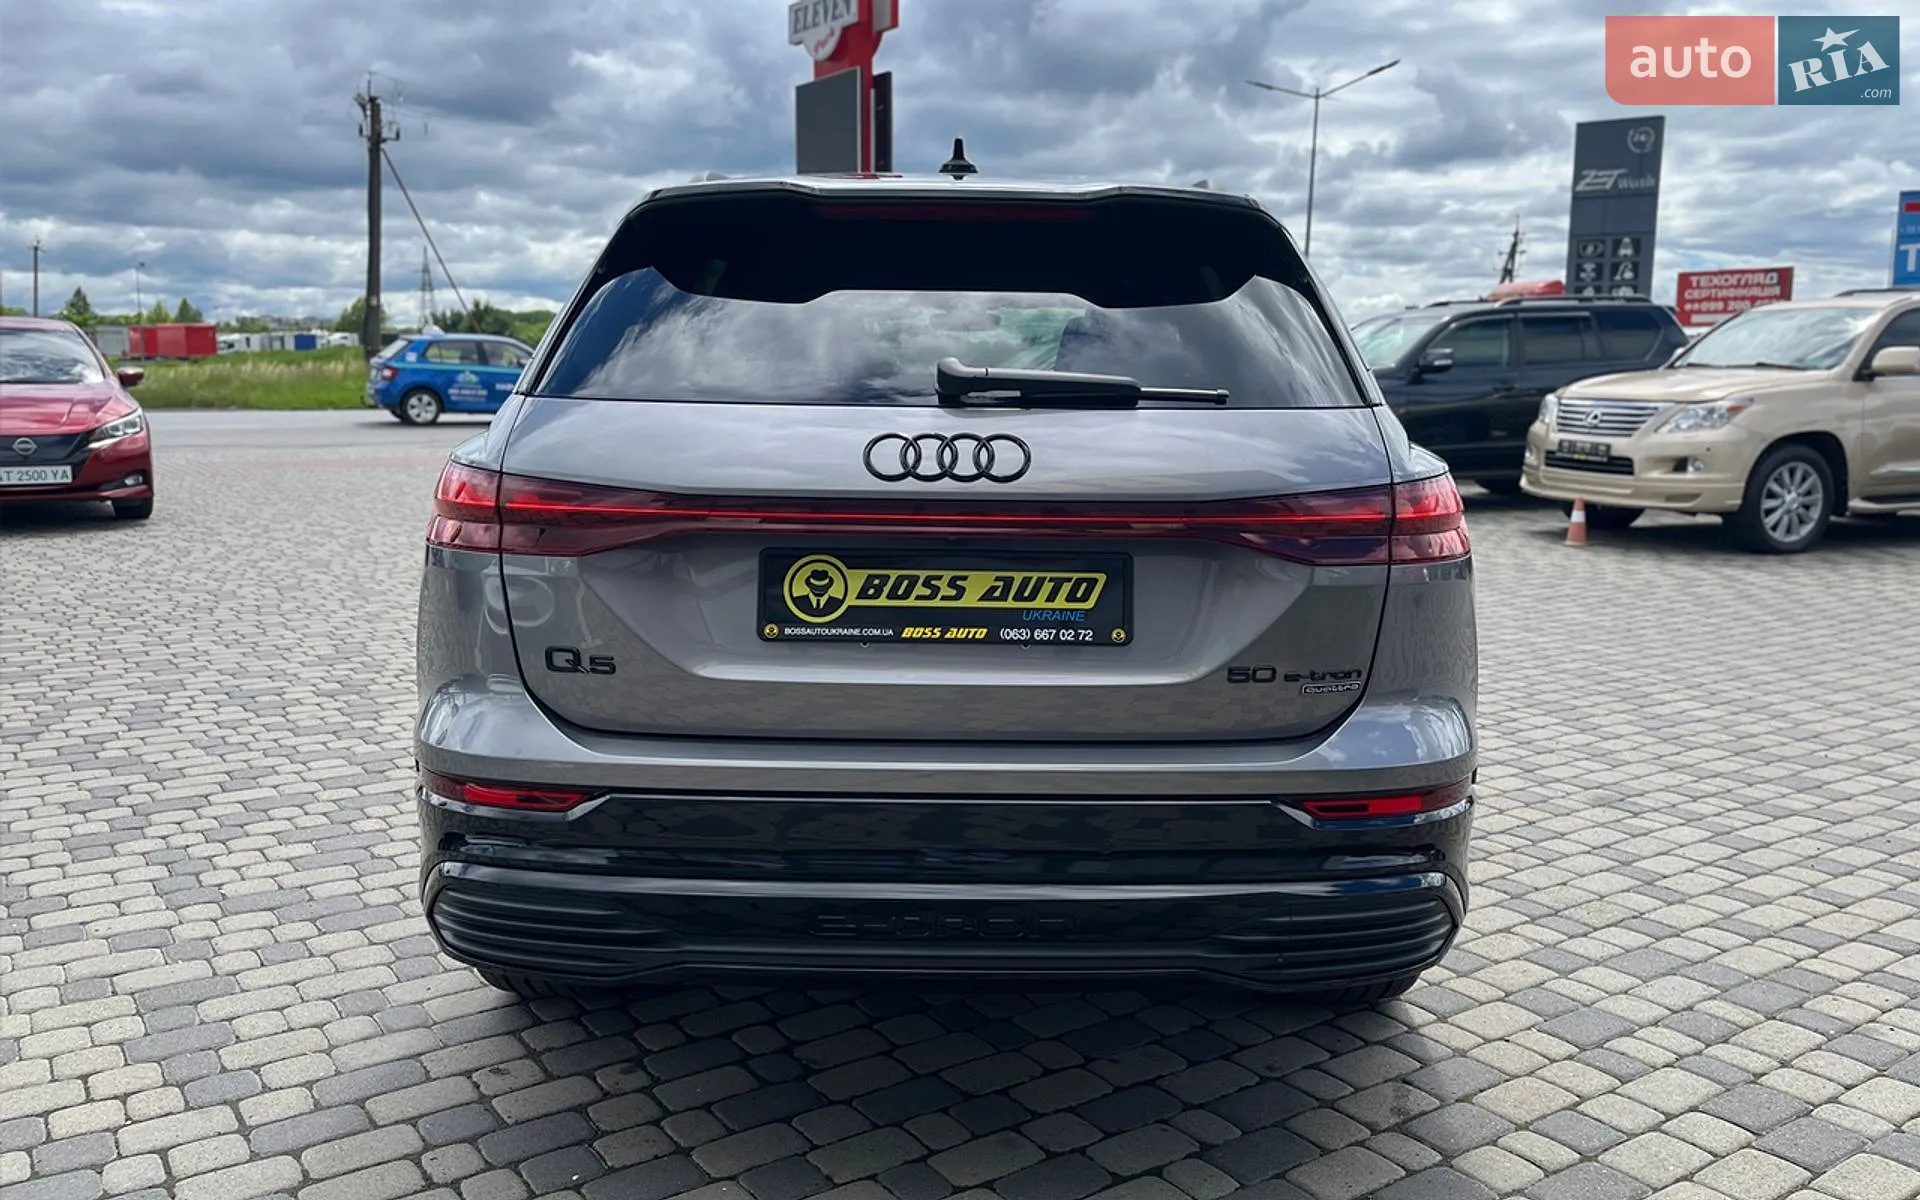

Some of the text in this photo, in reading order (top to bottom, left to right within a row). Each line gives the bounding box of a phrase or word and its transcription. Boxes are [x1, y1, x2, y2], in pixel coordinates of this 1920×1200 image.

[1688, 271, 1779, 288] ТЕХОГЛЯД
[17, 470, 48, 482] 2500
[855, 573, 1100, 603] BOSS AUTO
[1022, 610, 1087, 622] UKRAINE
[784, 627, 894, 637] BOSSAUTOUKRAINE.COM.UA
[901, 627, 989, 640] BOSS AUTO
[1000, 627, 1094, 642] (063) 667 02 72
[1227, 666, 1363, 684] 50 e-tron
[1305, 683, 1360, 694] quattro
